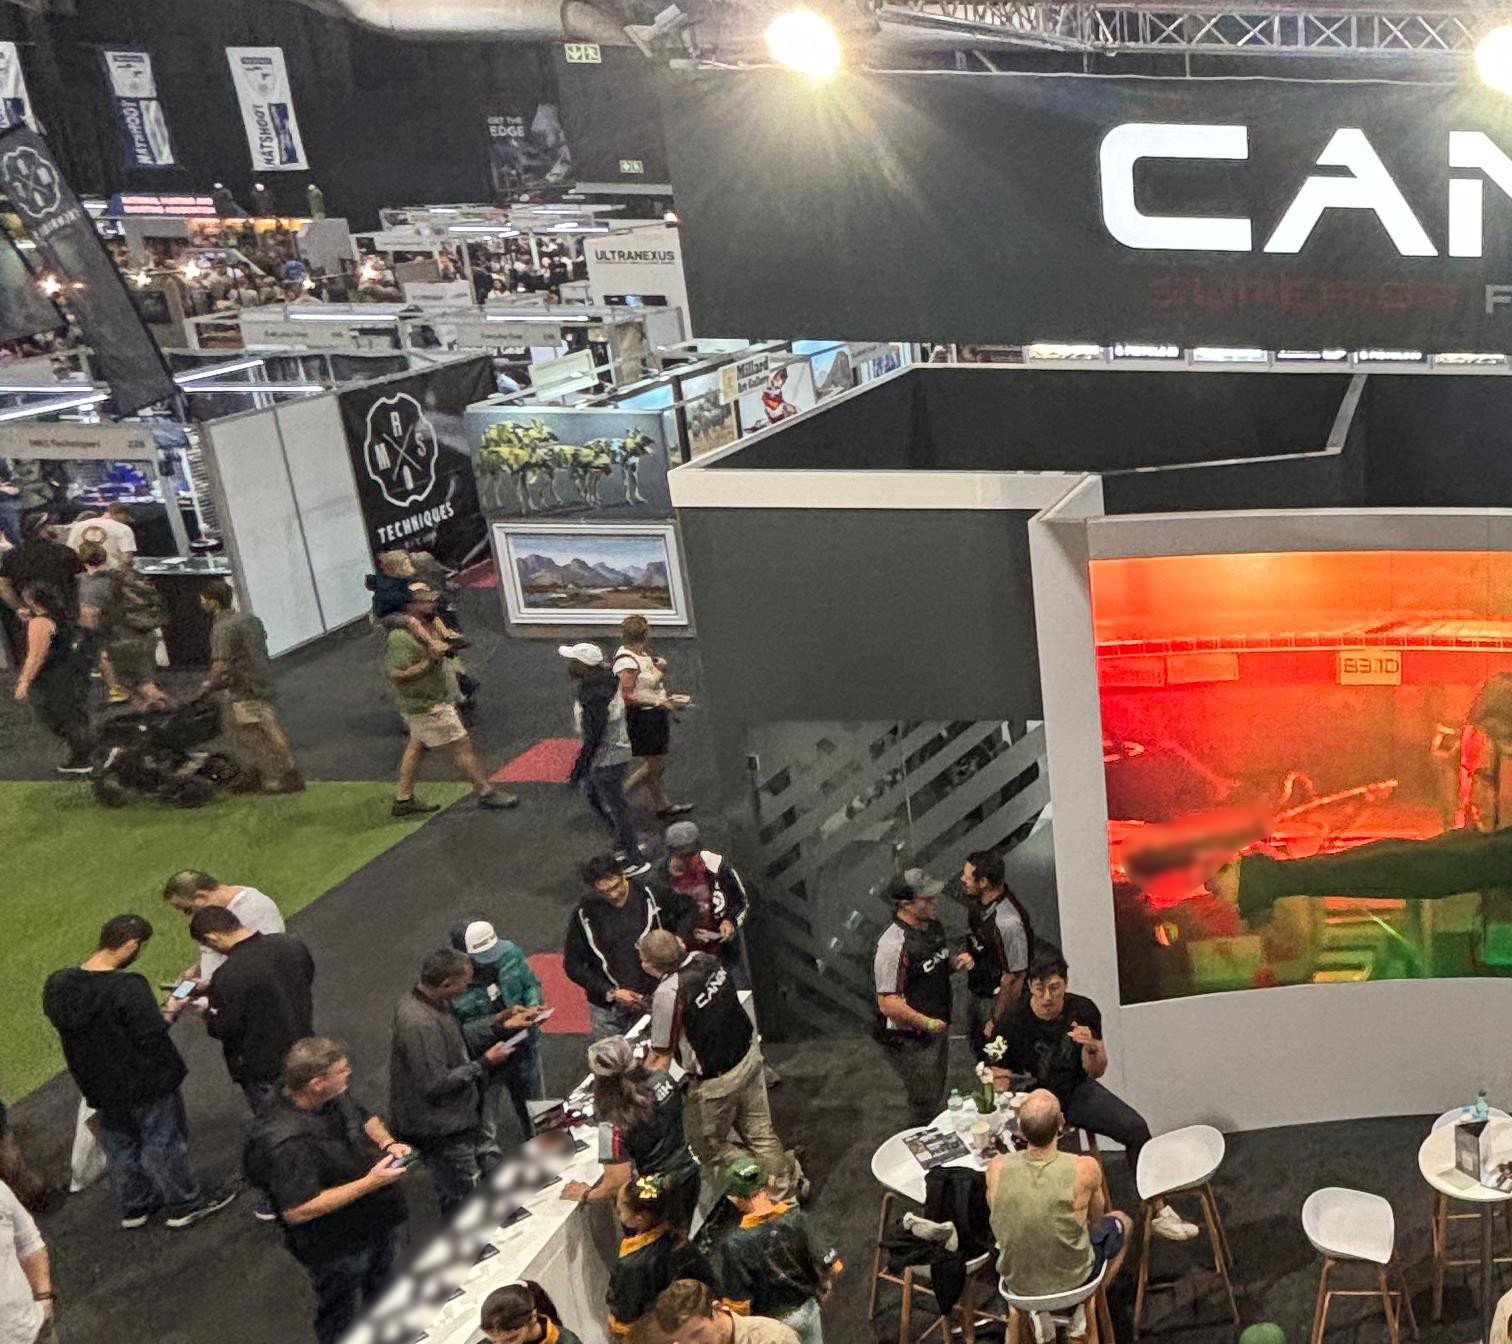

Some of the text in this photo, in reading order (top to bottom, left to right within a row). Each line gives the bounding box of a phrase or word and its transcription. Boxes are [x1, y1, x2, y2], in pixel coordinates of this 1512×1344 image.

[489, 125, 525, 137] EDGE
[595, 249, 675, 261] ULTRANEXUS
[737, 355, 769, 381] Millard
[377, 502, 455, 544] TECHNIQUES
